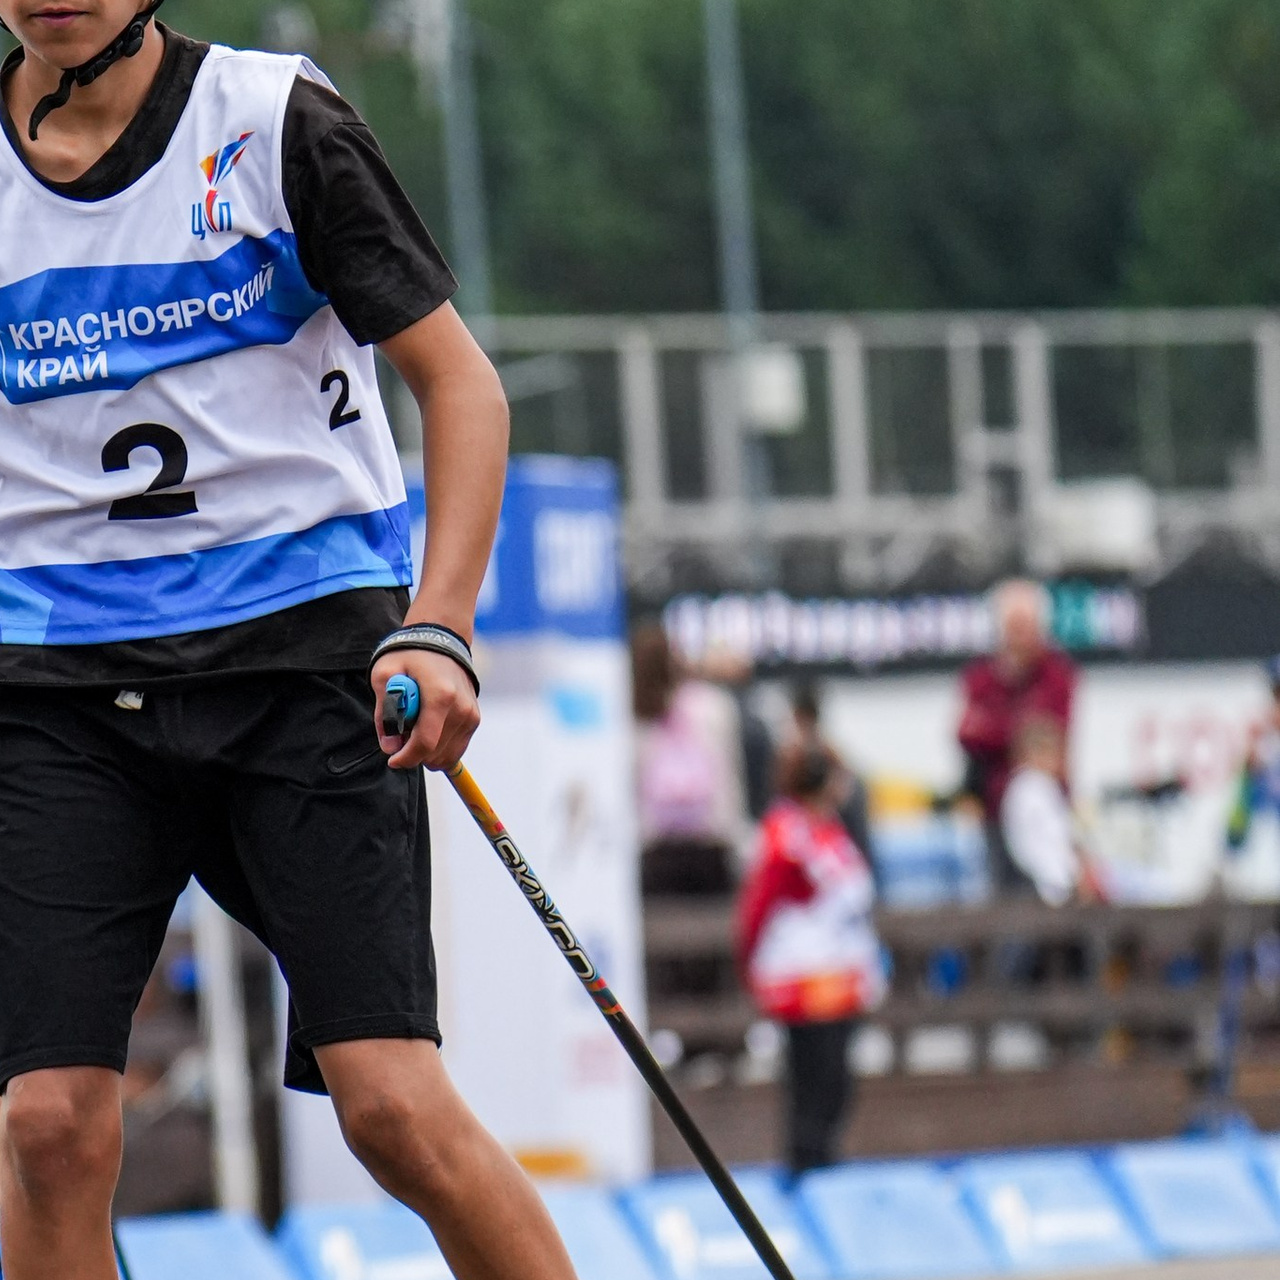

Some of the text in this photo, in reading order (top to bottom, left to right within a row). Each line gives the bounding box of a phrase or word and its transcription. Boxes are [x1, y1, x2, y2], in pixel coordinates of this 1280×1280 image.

[8, 261, 275, 352] КРАСНОЯРСКИЙ
[17, 345, 109, 389] КРАЙ
[320, 369, 362, 432] 2
[101, 422, 199, 521] 2
